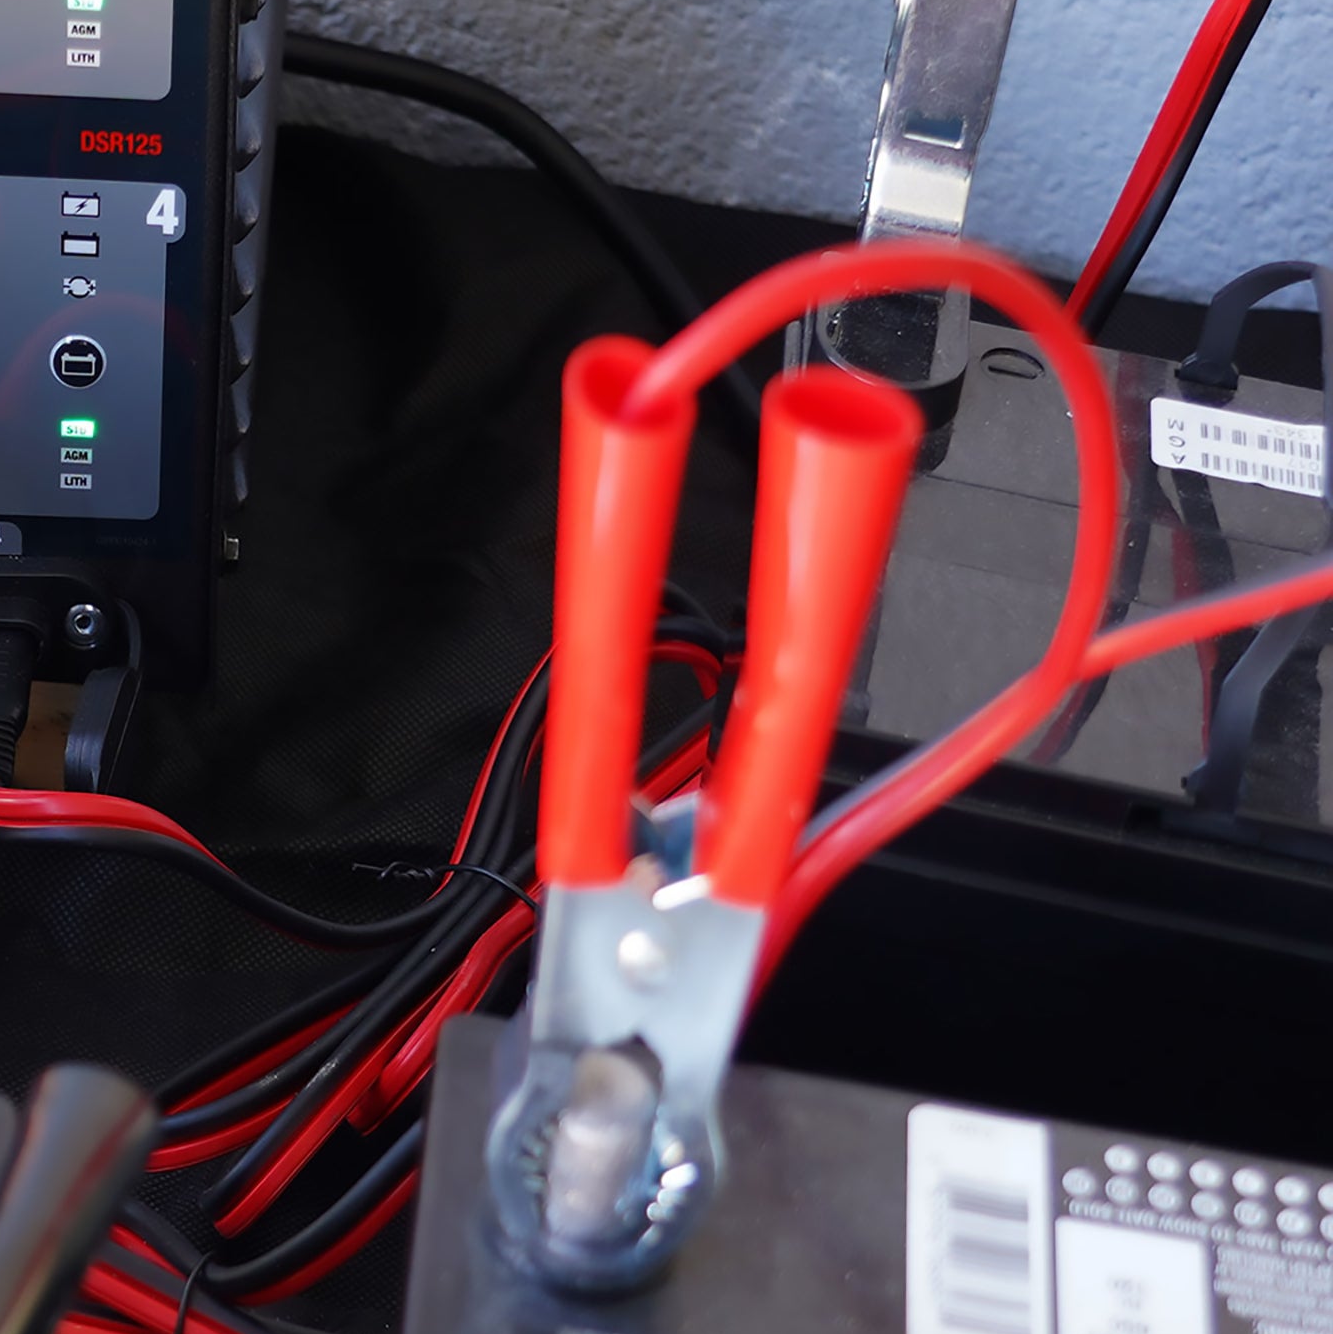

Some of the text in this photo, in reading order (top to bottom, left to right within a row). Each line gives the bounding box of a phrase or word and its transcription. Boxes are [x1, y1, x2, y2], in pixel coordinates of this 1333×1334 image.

[71, 25, 96, 36] AGM
[71, 53, 95, 63] LITH
[81, 130, 162, 156] DSR125
[146, 190, 179, 235] 4
[64, 450, 89, 461] AGM
[64, 476, 87, 486] LITH
